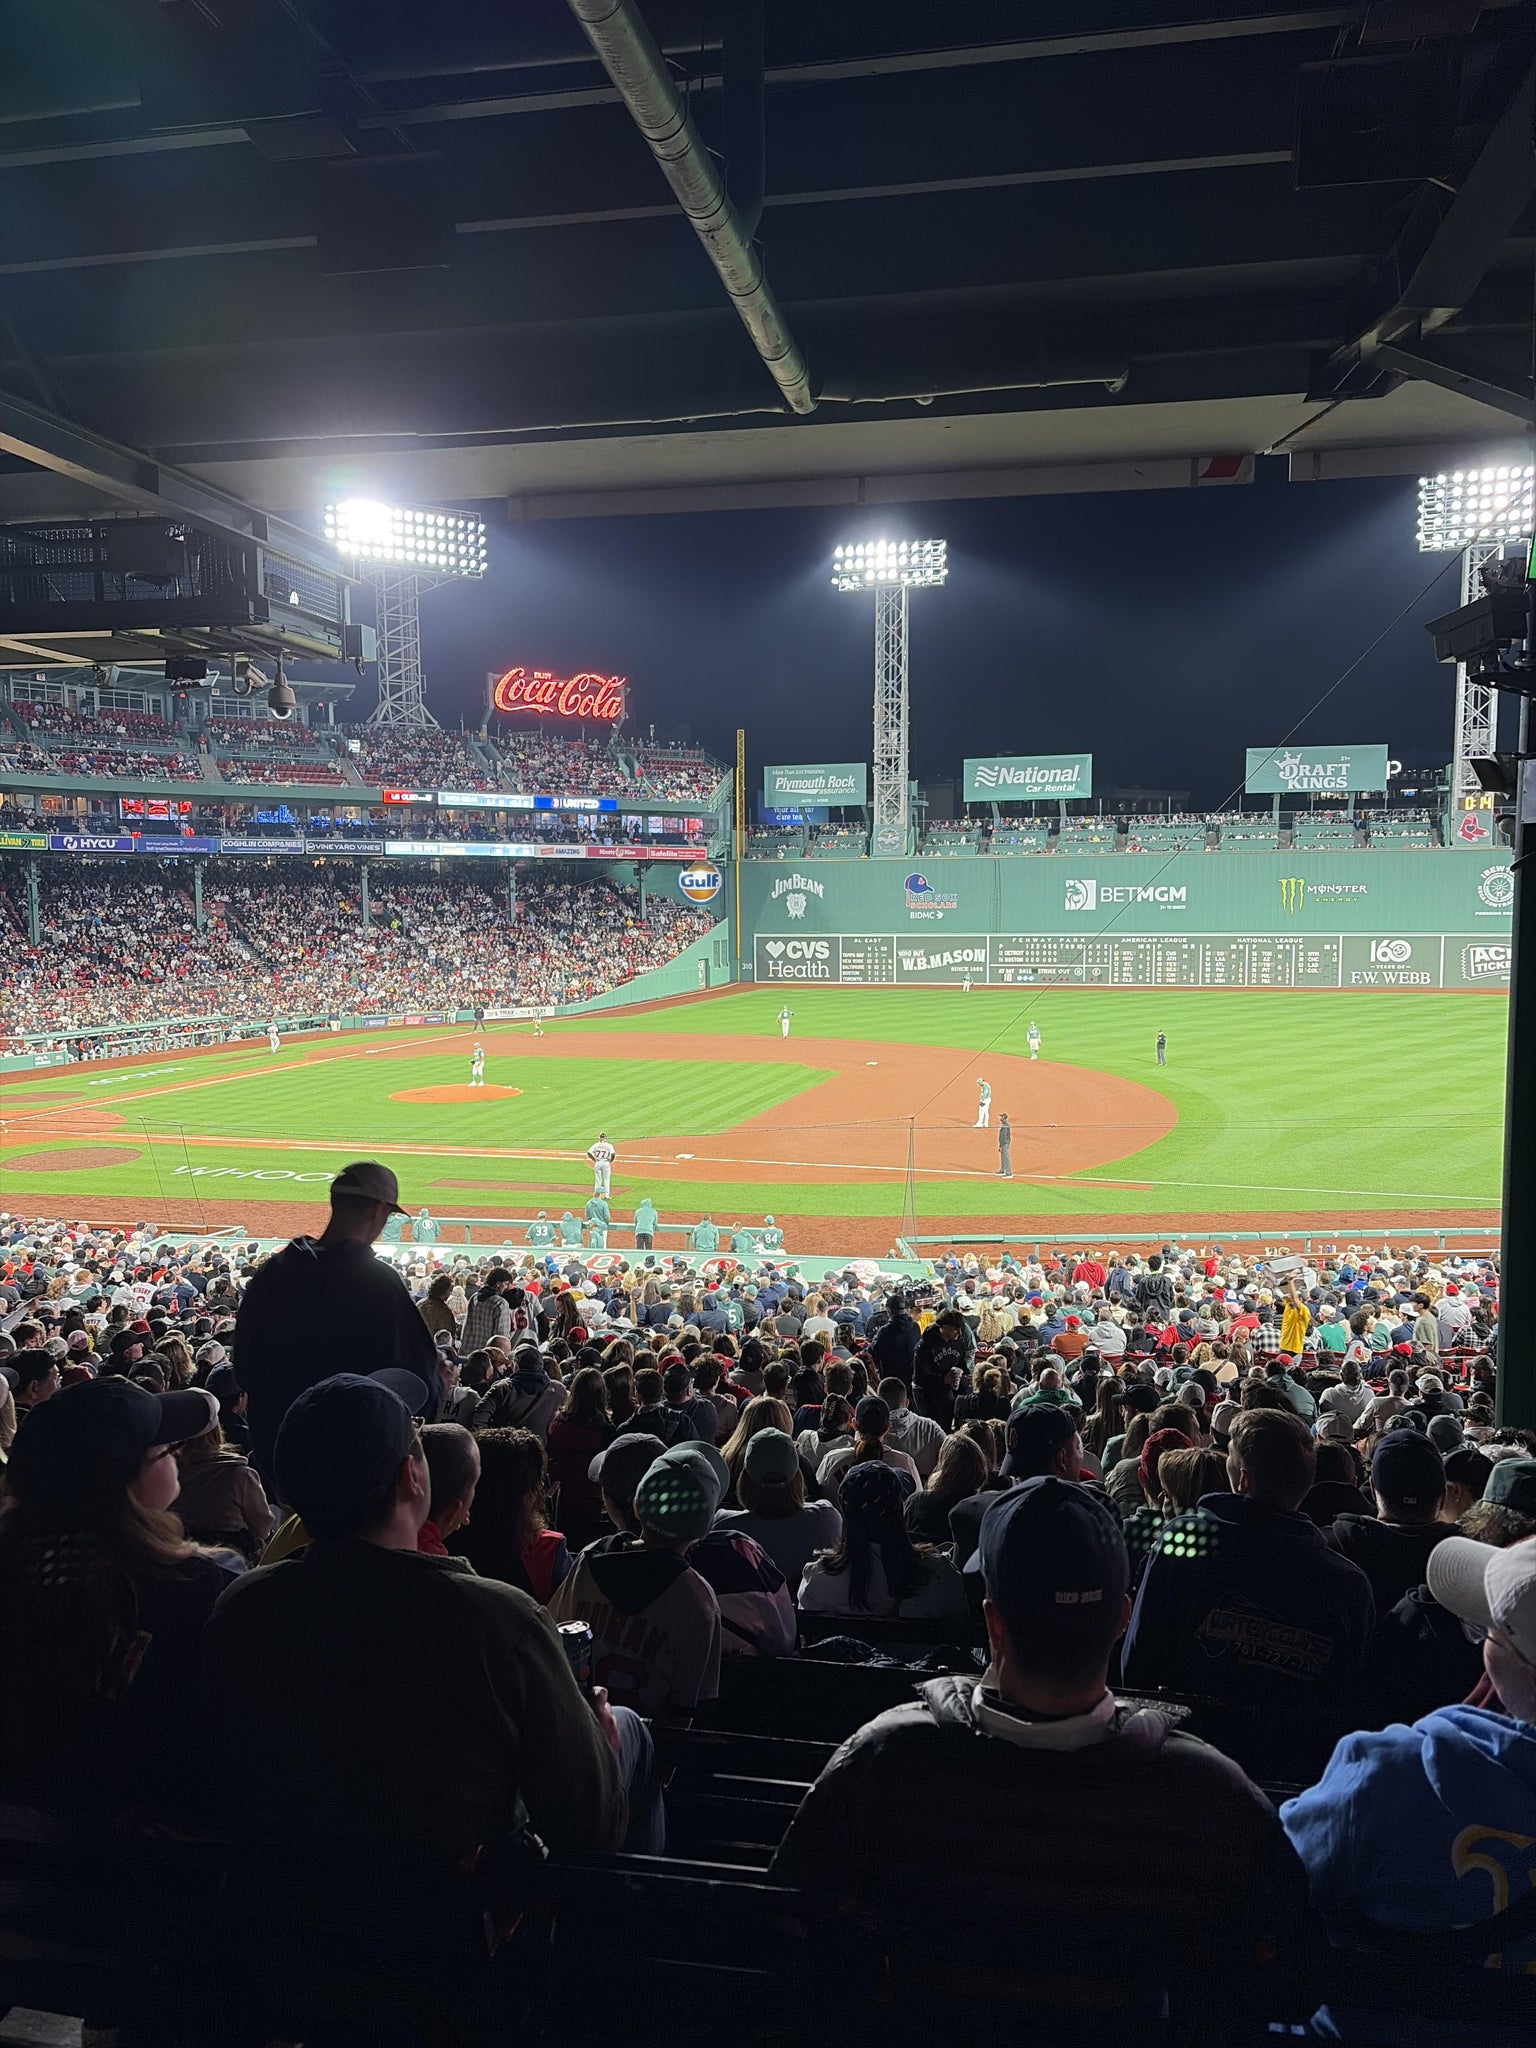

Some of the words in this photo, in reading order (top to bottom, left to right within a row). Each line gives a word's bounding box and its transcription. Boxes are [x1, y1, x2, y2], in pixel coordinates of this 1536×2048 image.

[495, 667, 626, 718] Coca-Cola
[998, 765, 1080, 784] National
[1279, 763, 1350, 780] DRAFT
[775, 776, 826, 790] Plymouth
[827, 775, 855, 788] Rock
[1026, 785, 1042, 793] Car
[1045, 784, 1075, 792] Rental
[1287, 777, 1348, 789] KINGS
[31, 838, 45, 847] TIRE
[81, 838, 115, 849] HYCU
[223, 840, 257, 848] COGHLIN
[314, 843, 354, 851] VINEYARD
[681, 873, 719, 888] Gulf
[910, 893, 932, 901] RED
[936, 893, 958, 901] SOX
[1100, 886, 1186, 902] BETMGM
[786, 940, 830, 959] CVS
[1370, 939, 1412, 963] 160
[768, 960, 830, 978] Health
[1475, 960, 1511, 973] TICKE
[1350, 972, 1379, 984] F.W.
[1382, 972, 1431, 985] WEBB
[595, 1150, 607, 1158] 77
[171, 1165, 336, 1182] WHOO
[535, 1226, 548, 1237] 33
[764, 1233, 778, 1244] 84
